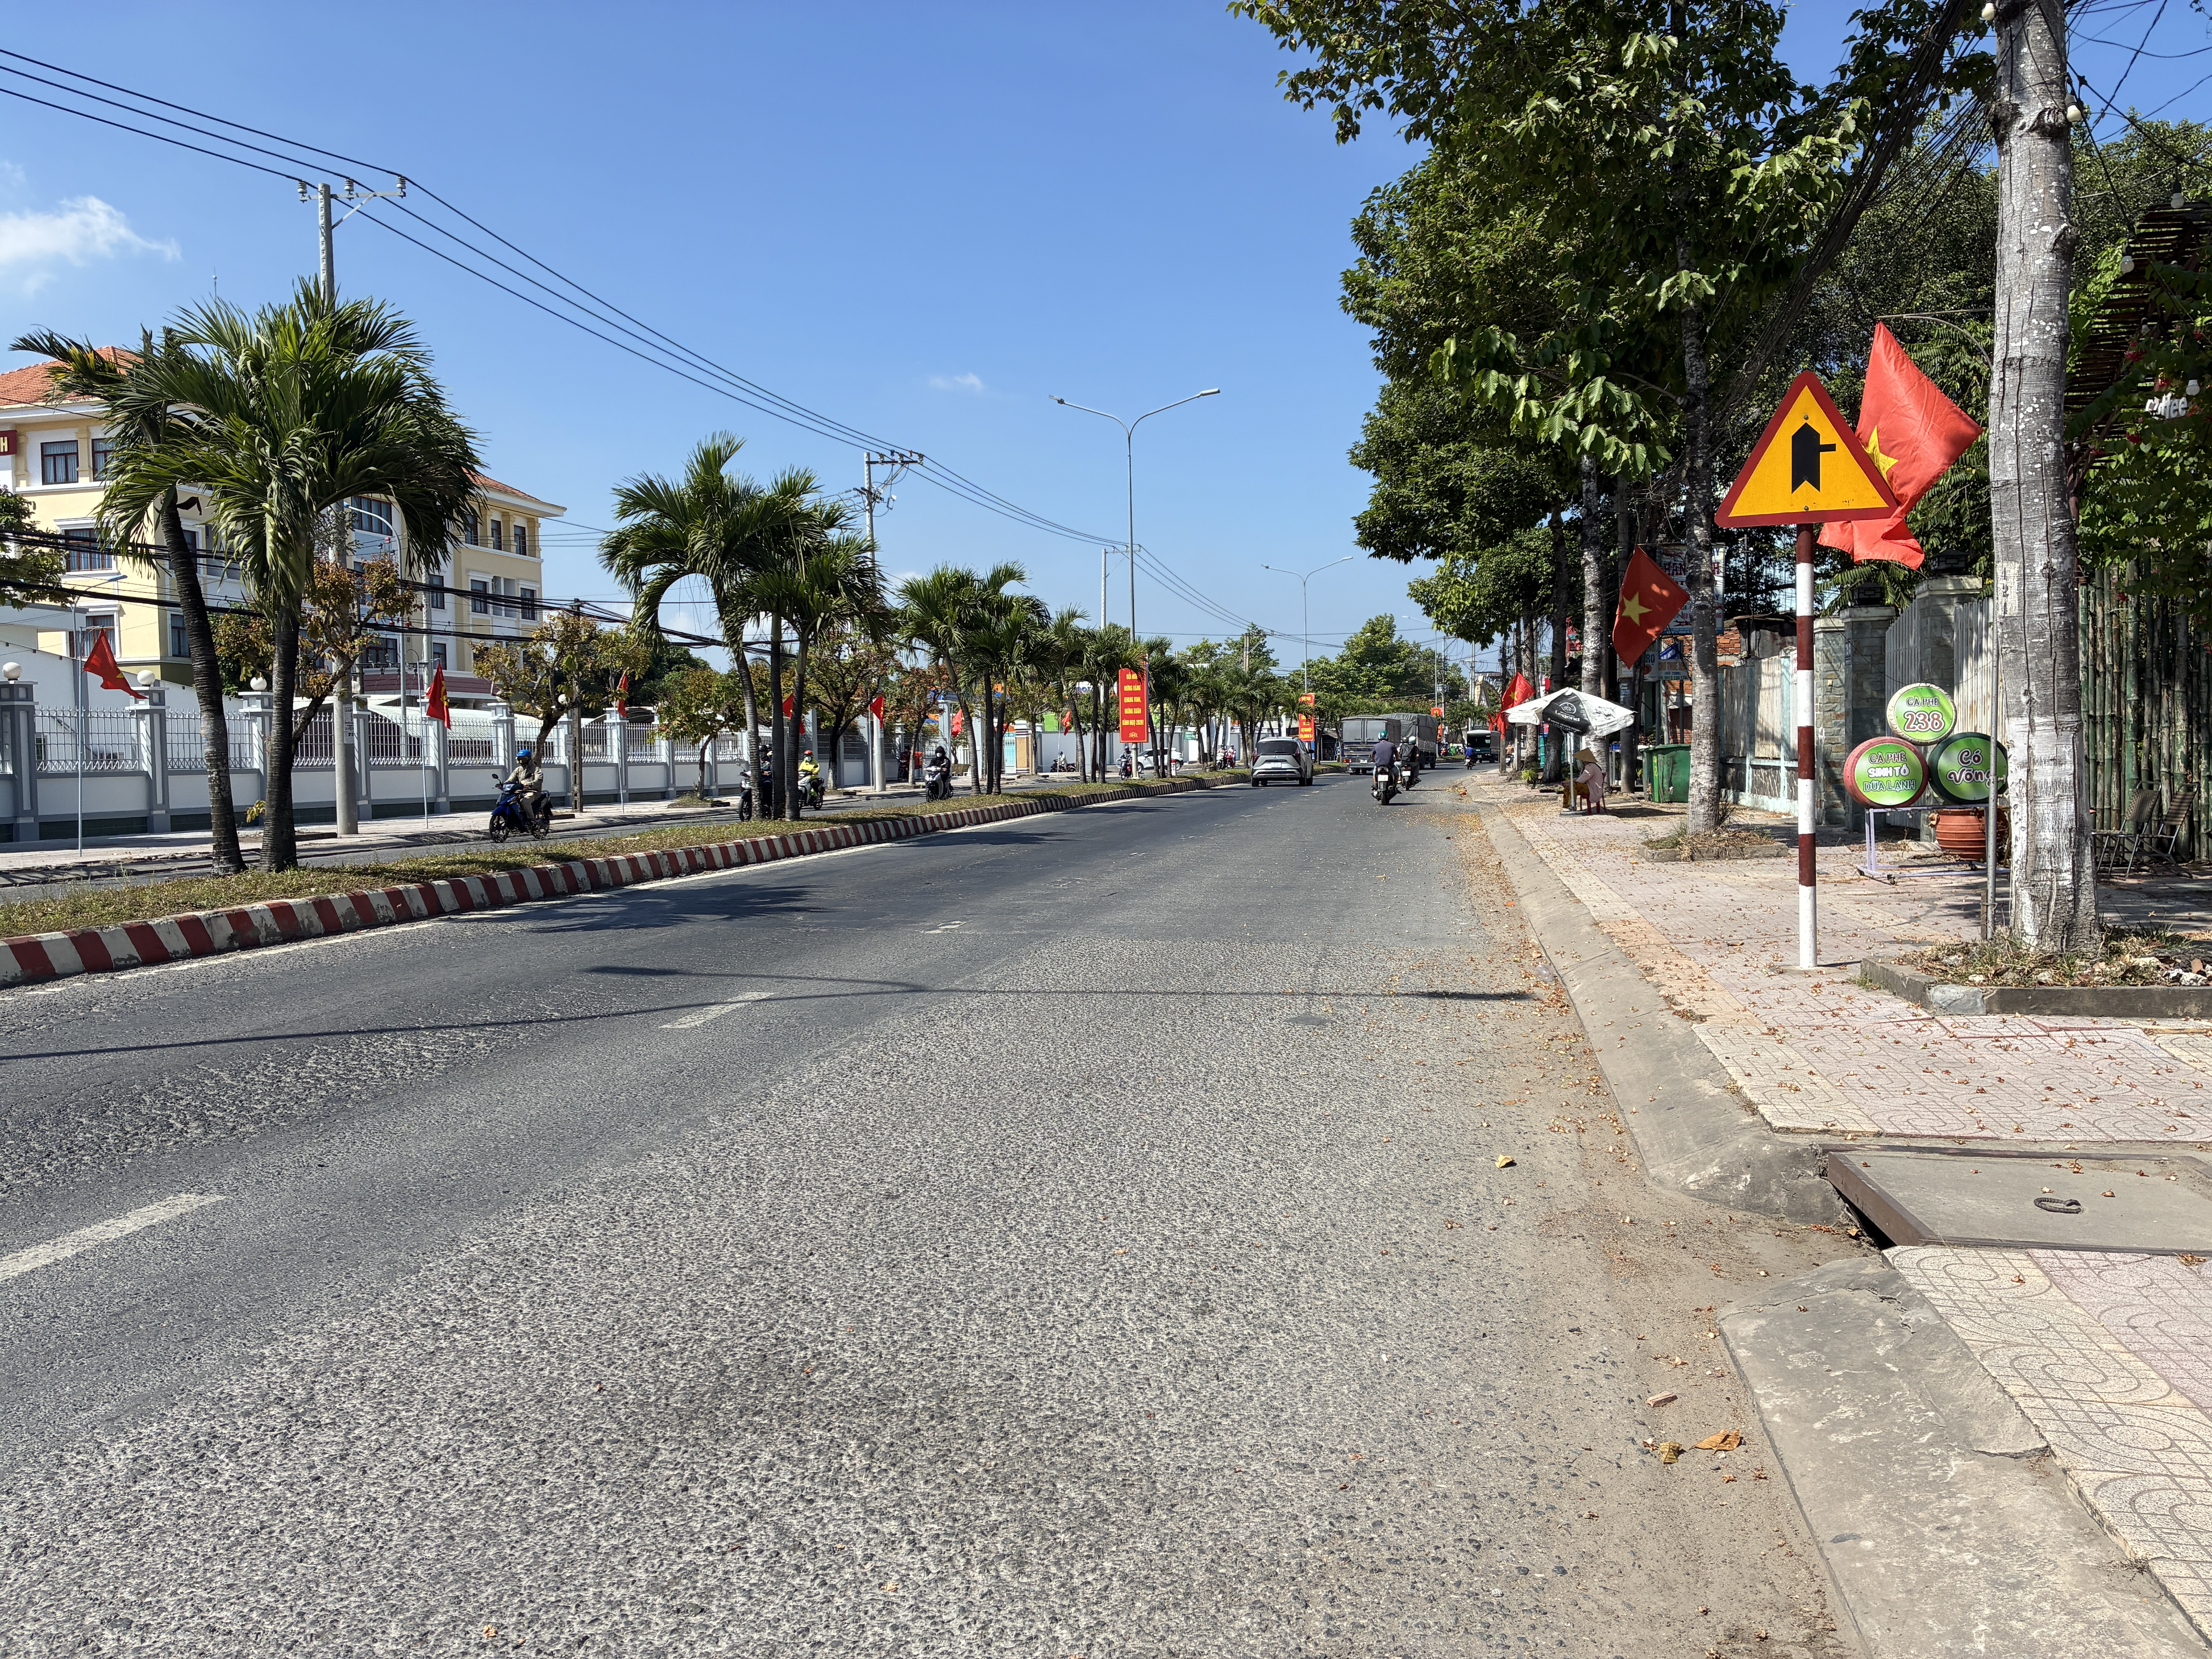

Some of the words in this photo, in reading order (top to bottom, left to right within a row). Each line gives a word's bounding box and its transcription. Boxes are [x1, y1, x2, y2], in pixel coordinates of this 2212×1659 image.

[1906, 696, 1920, 707] CÀ
[1922, 696, 1941, 707] PHÊ
[1904, 711, 1945, 732] 238
[1869, 752, 1885, 764] CÀ
[1886, 750, 1906, 763] PHÊ
[1958, 748, 1983, 766] Có
[1868, 767, 1893, 778] SINH
[1887, 779, 1916, 792] LẠNH
